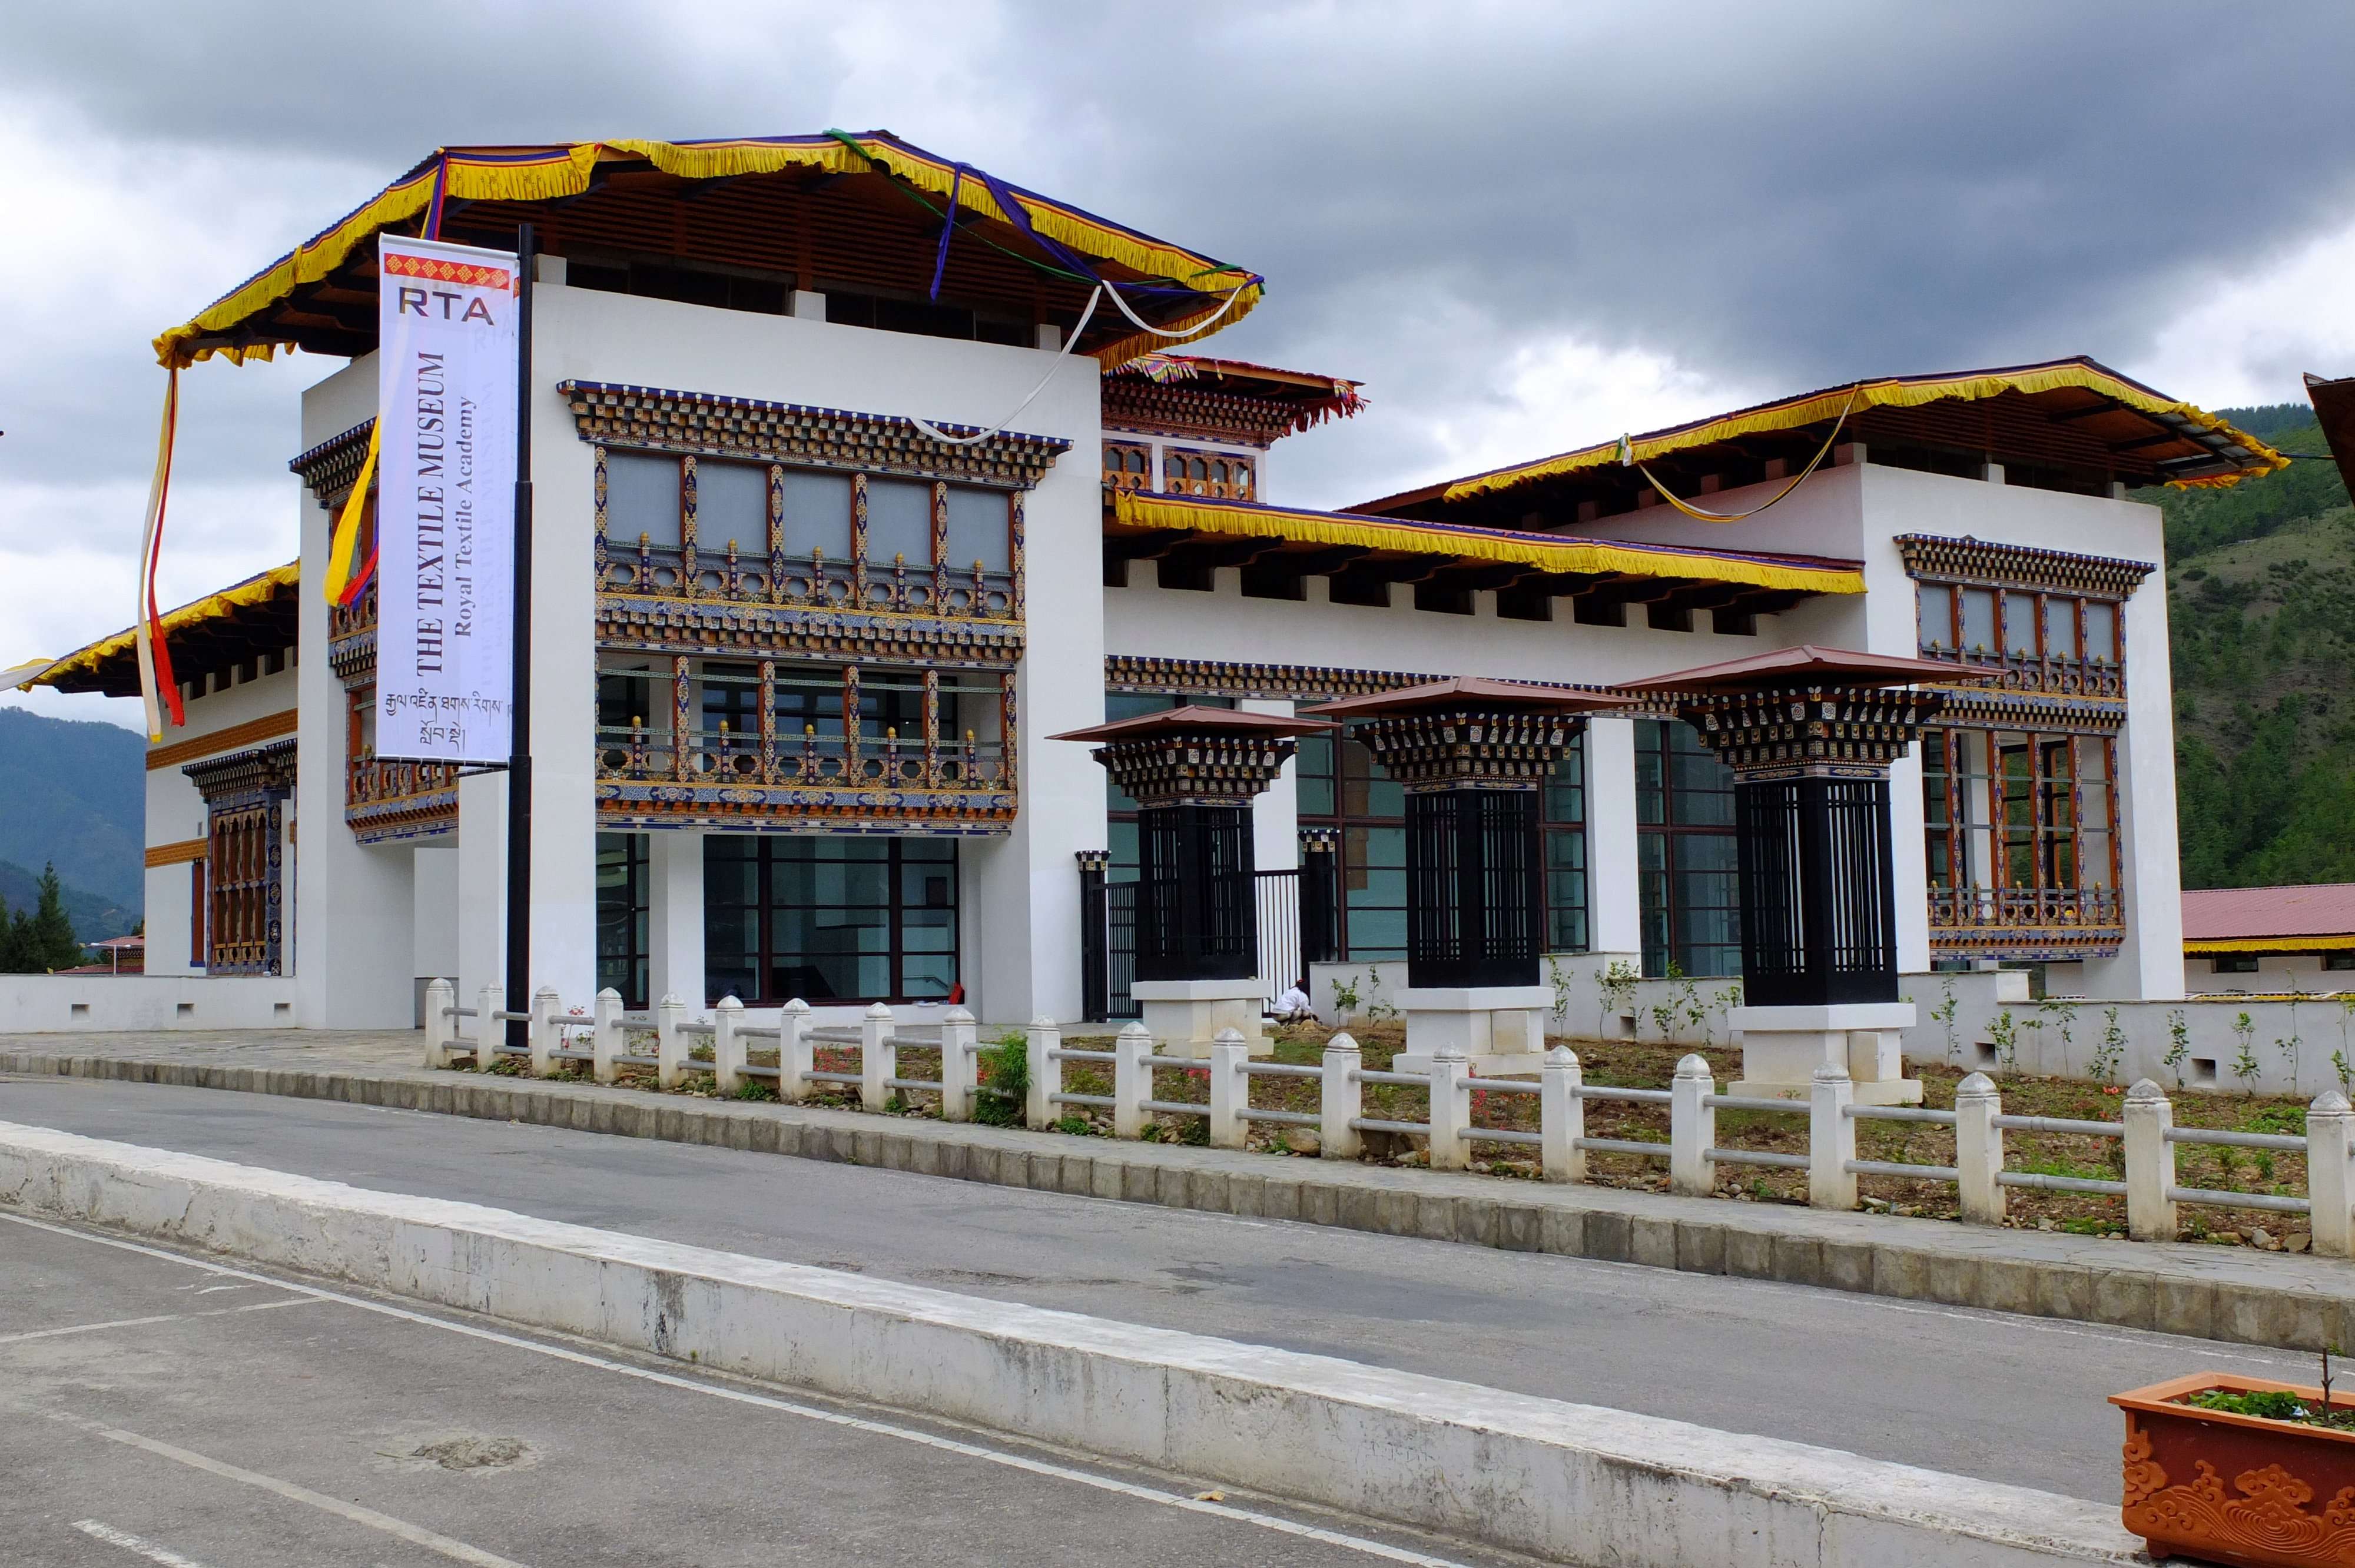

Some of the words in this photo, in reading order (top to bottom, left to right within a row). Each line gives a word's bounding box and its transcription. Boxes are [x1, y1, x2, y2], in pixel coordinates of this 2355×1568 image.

[399, 287, 495, 325] RTA
[417, 351, 444, 479] MUSEUM
[455, 396, 476, 494] Academy
[417, 486, 443, 610] TEXTILE
[455, 500, 472, 569] Textile
[455, 576, 476, 637] Royal
[417, 619, 442, 677] THE
